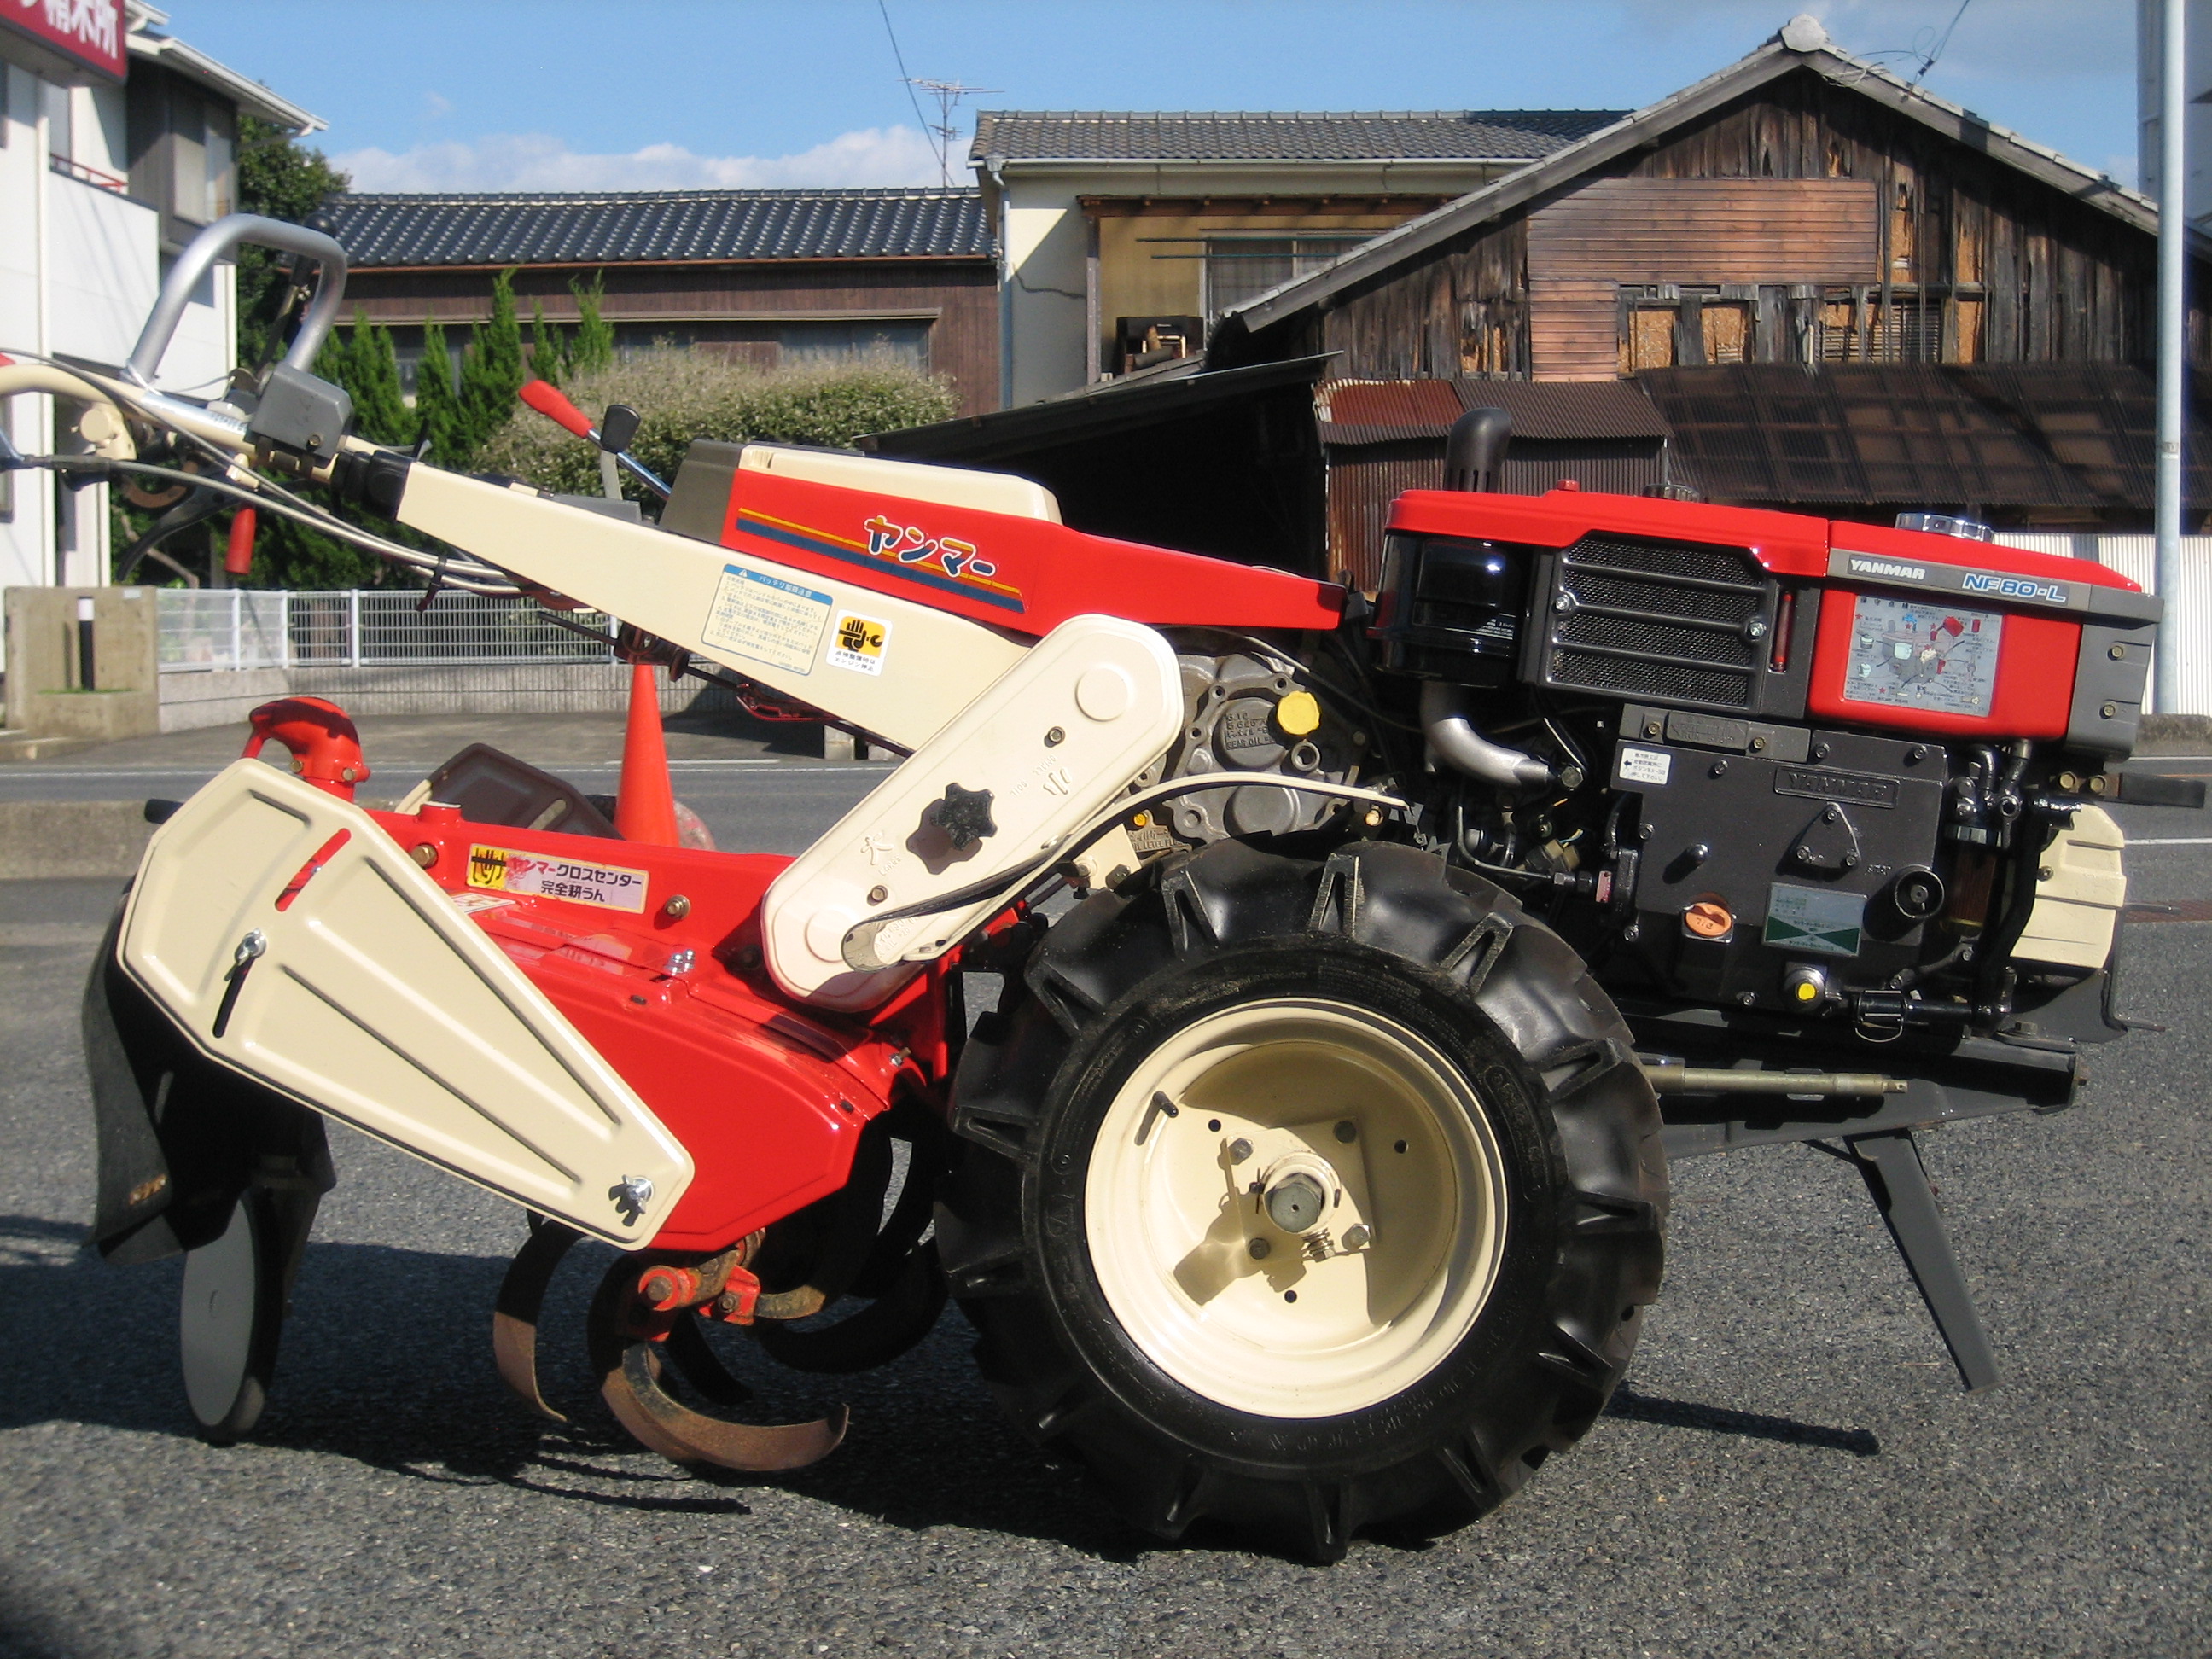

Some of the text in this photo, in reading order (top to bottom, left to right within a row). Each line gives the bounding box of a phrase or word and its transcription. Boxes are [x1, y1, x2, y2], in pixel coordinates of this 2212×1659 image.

[864, 515, 996, 577] ヤンマー
[1849, 559, 2068, 603] YANMAR NF80-L
[540, 880, 606, 903] 完全耕うん
